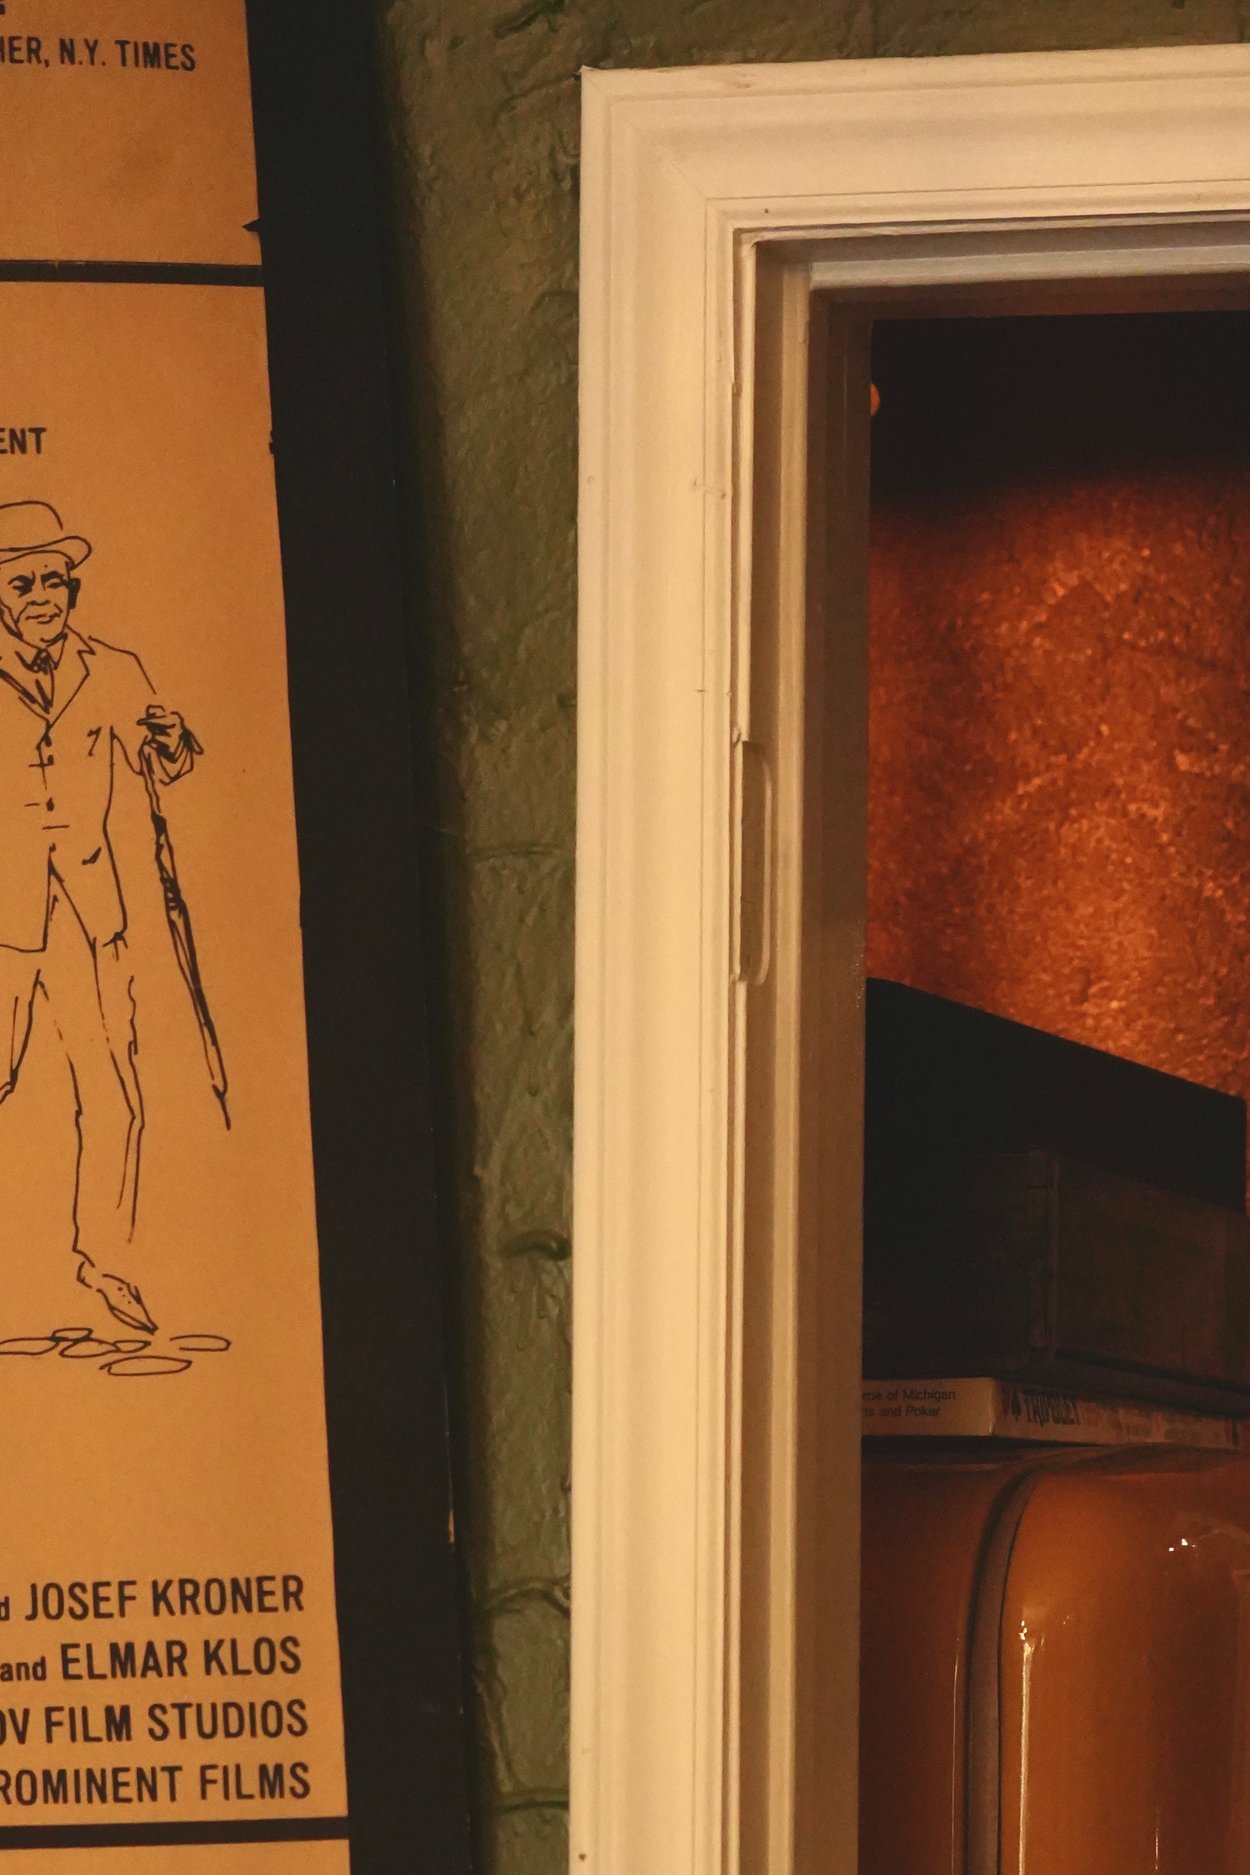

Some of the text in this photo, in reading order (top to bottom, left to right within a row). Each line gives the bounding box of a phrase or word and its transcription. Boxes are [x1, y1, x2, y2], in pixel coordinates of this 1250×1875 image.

[59, 38, 106, 66] N.Y.
[115, 39, 196, 72] TIMES
[25, 1580, 137, 1622] JOSEF
[151, 1574, 304, 1617] KRONER
[0, 1635, 302, 1682] and ELMAR KLOS
[44, 1704, 132, 1744] FILM
[147, 1698, 309, 1742] STUDIOS
[199, 1761, 311, 1801] FILMS
